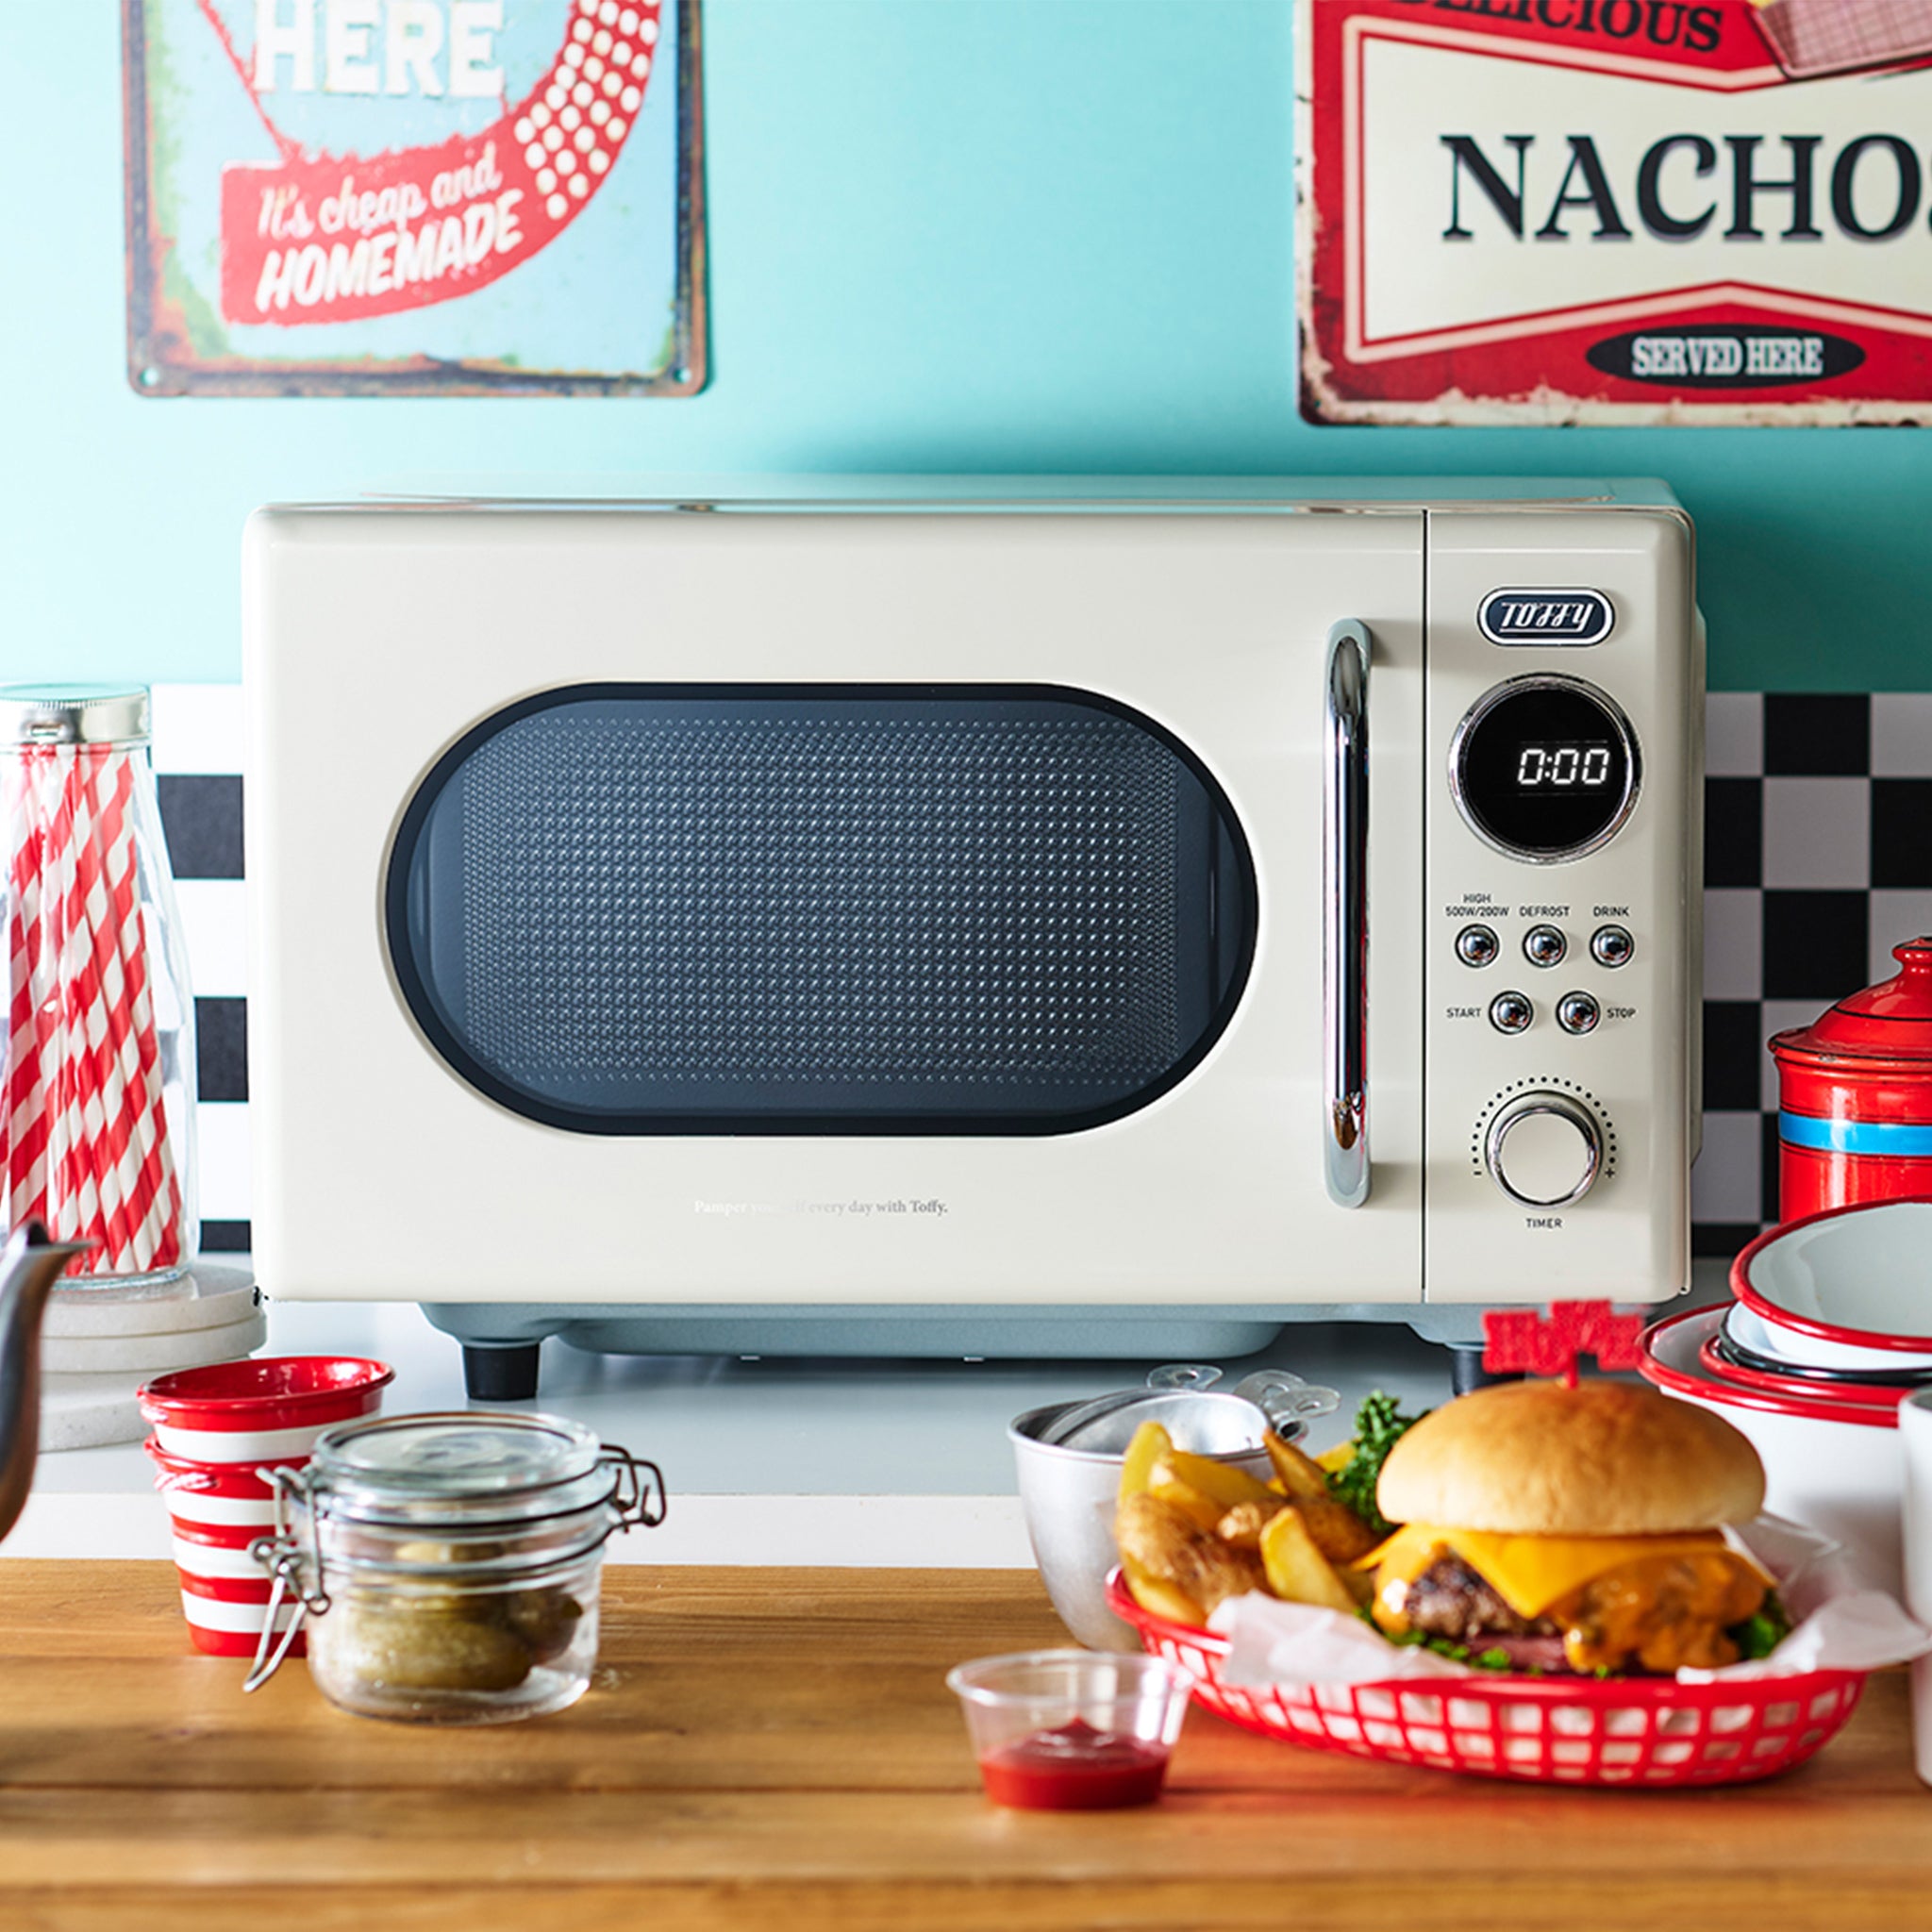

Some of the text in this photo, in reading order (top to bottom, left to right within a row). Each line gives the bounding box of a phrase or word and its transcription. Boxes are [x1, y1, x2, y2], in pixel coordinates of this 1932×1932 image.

[254, 0, 505, 97] HERE
[258, 140, 504, 241] It's cheap and
[1439, 133, 1932, 243] NACHO
[254, 187, 525, 314] HOMEMADE
[1631, 337, 1824, 376] SERVED HERE
[1517, 748, 1610, 785] 0:00
[1462, 893, 1491, 904] HIGH
[1445, 907, 1509, 917] 500W/200W
[1519, 906, 1571, 918] DEFROST
[1592, 906, 1630, 918] DRINK
[1446, 1008, 1482, 1019] START
[1607, 1008, 1637, 1019] STOP
[848, 1200, 874, 1217] day
[875, 1200, 907, 1213] with
[908, 1199, 948, 1217] Toffy.
[1525, 1217, 1563, 1228] TIMER
